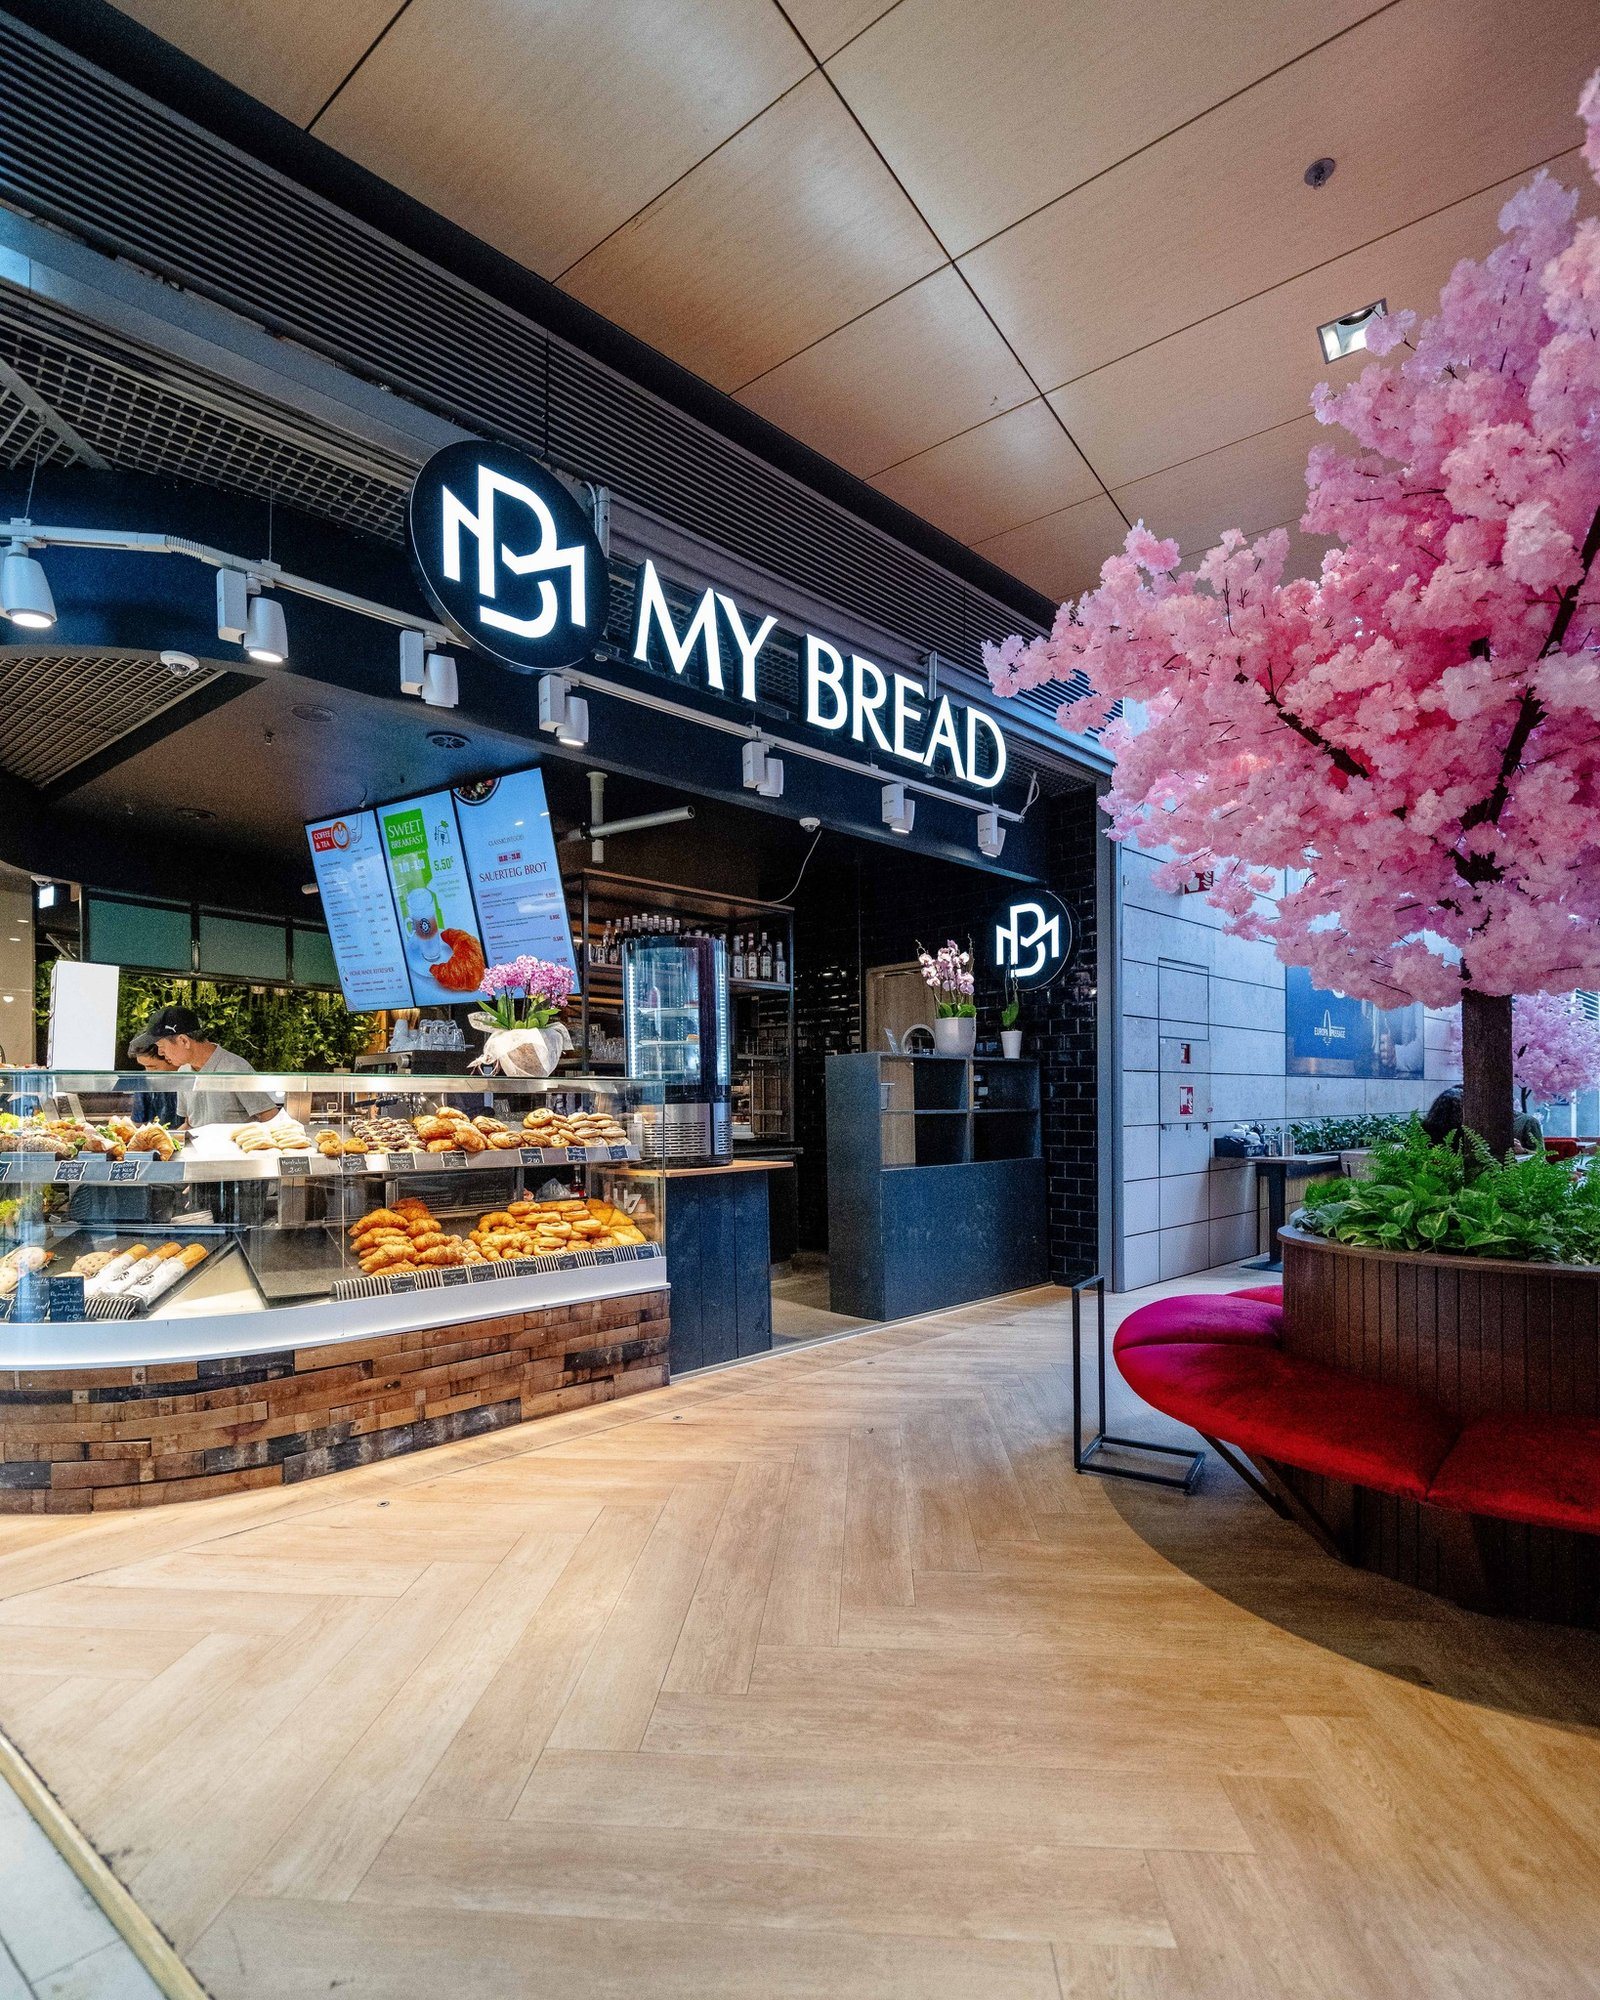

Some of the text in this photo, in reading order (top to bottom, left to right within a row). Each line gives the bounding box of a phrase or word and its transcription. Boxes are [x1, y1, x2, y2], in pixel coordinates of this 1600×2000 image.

[633, 558, 1008, 789] MY BREAD
[313, 830, 331, 840] COFFEE
[388, 819, 421, 838] SWEET
[321, 840, 331, 848] TEA
[390, 834, 424, 849] BREAKFAST
[479, 861, 548, 883] SAUERTEIG BROT
